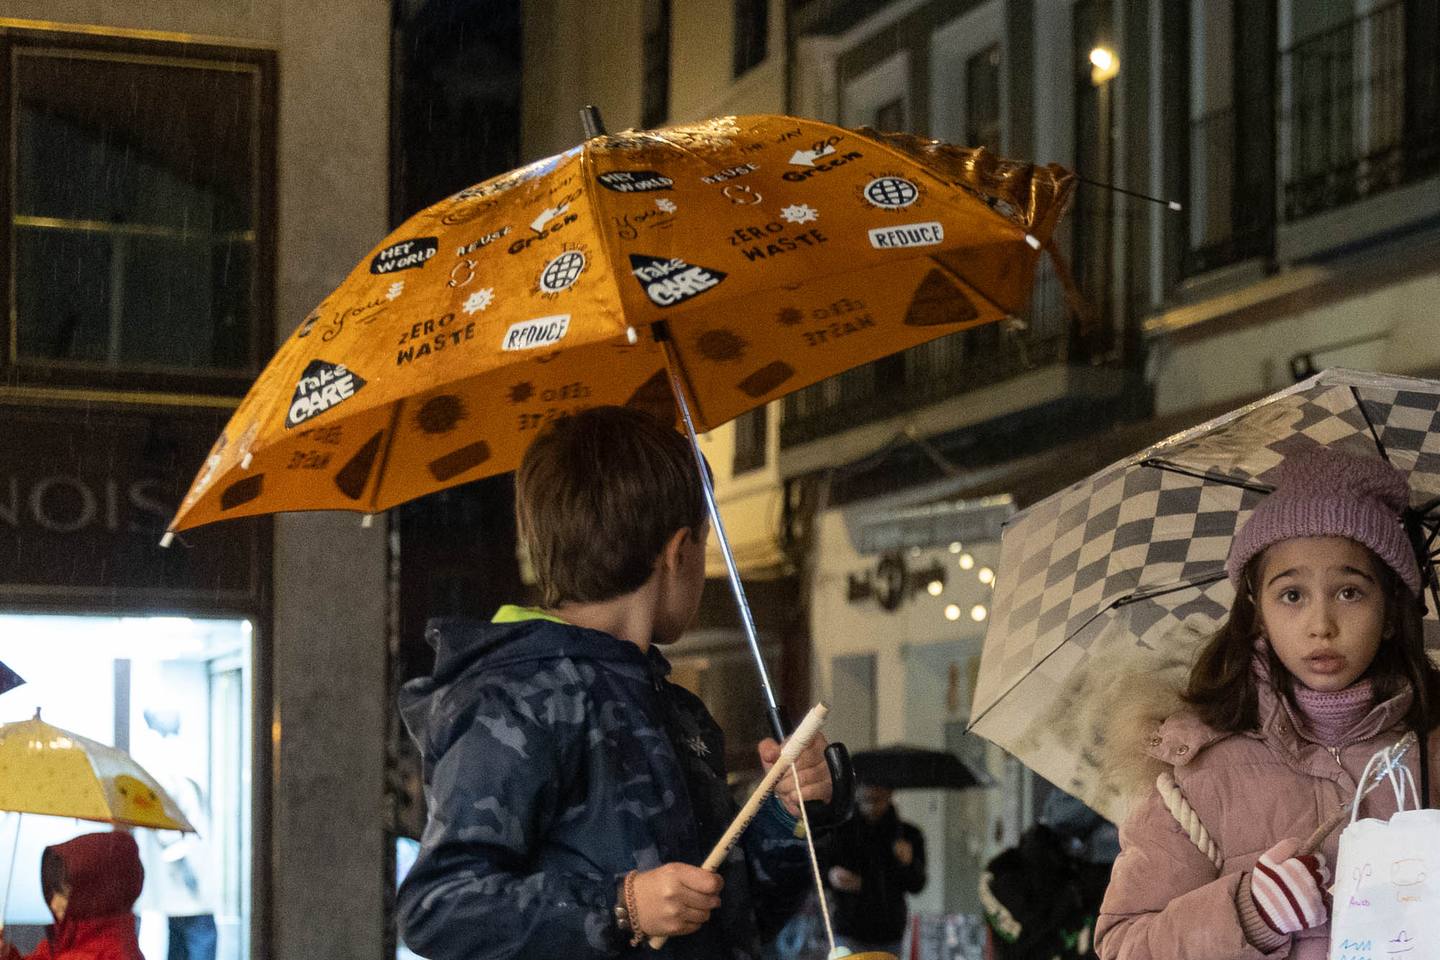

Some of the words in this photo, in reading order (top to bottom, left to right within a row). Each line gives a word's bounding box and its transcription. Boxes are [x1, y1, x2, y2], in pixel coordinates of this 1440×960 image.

[600, 172, 635, 183] HEY
[701, 163, 760, 184] REUSE
[782, 151, 863, 182] Green
[613, 177, 674, 192] WORLD
[508, 213, 578, 254] Green
[741, 228, 828, 262] WASTE
[875, 225, 942, 248] REDUCE
[376, 248, 437, 273] WORLD
[380, 241, 415, 260] HEY
[632, 258, 687, 281] Take
[648, 267, 720, 305] CARE
[396, 322, 476, 366] WASTE
[508, 319, 567, 348] REDUCE
[296, 364, 348, 395] Take
[289, 374, 355, 424] CARE
